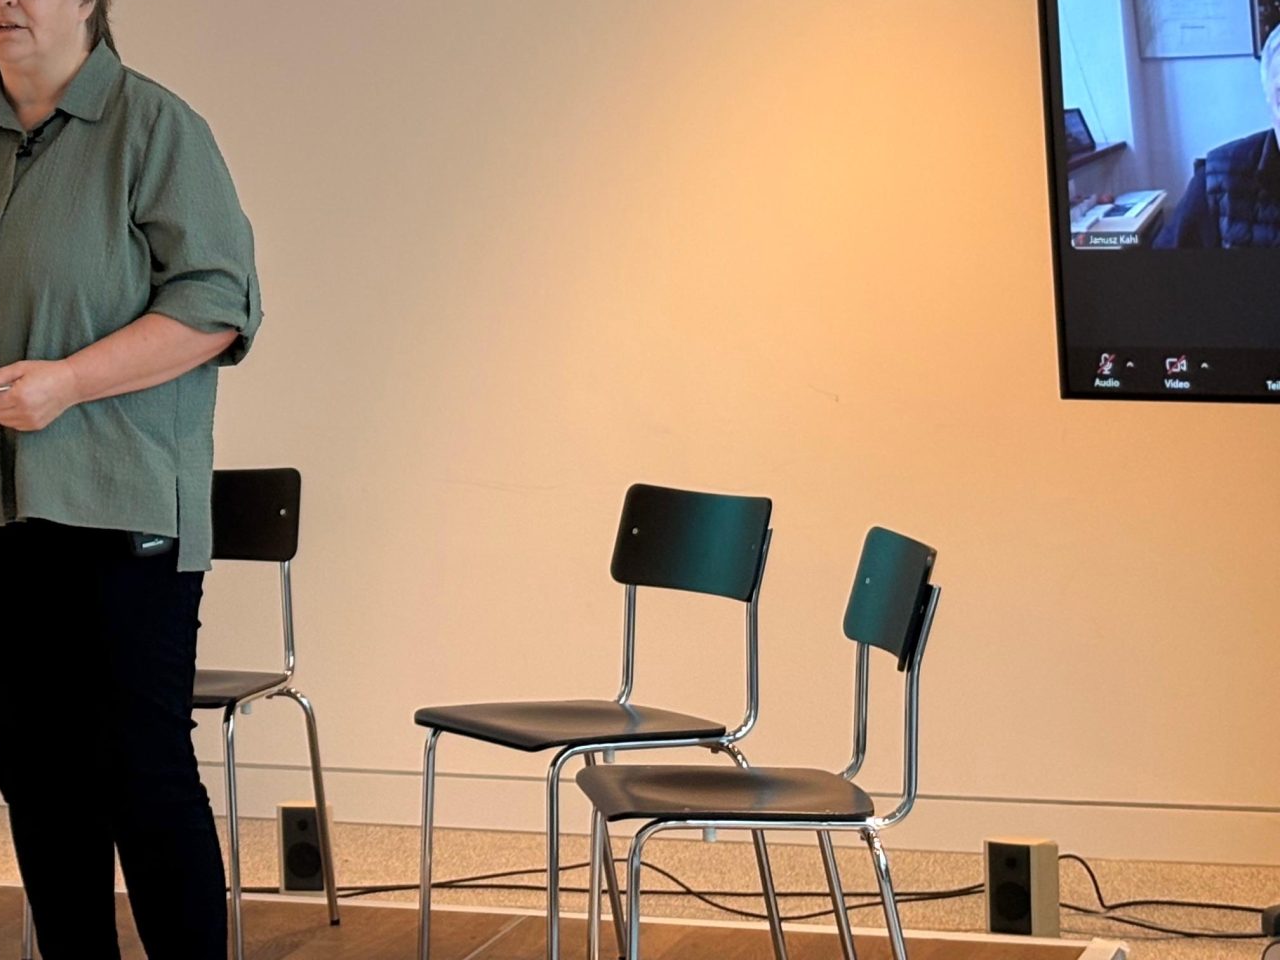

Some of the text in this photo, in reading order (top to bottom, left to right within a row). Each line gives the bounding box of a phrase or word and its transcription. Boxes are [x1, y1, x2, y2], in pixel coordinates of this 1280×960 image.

[1088, 234, 1139, 245] Janusz Kahl
[1094, 378, 1120, 388] Audio
[1164, 378, 1190, 389] Video
